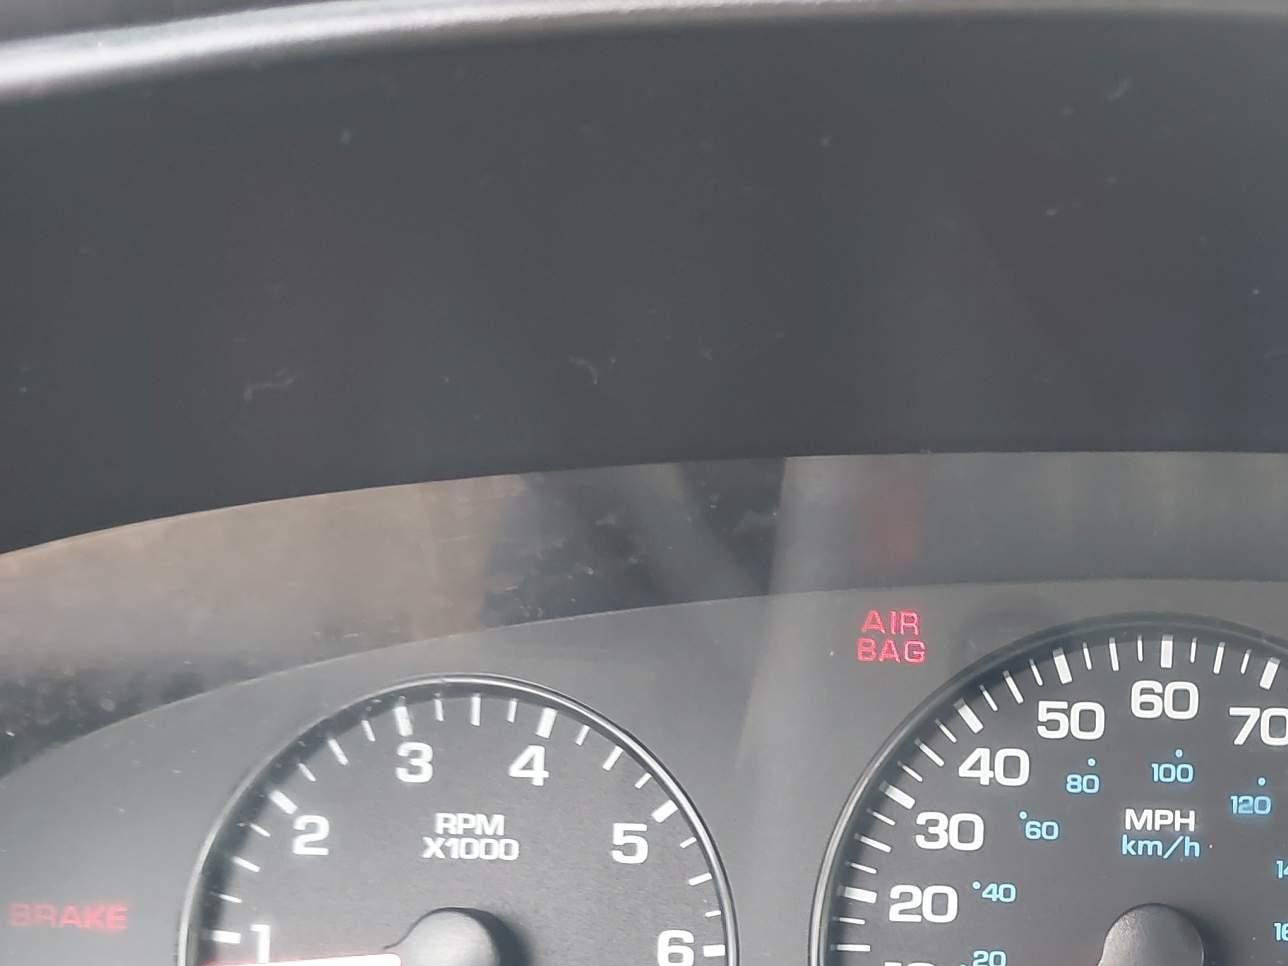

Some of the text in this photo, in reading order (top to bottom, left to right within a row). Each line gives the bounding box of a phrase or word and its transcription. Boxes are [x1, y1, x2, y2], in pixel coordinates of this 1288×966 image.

[862, 610, 920, 635] AIR
[857, 639, 925, 663] BAG
[1131, 680, 1199, 718] 60
[1037, 702, 1105, 739] 50
[396, 744, 433, 782] 3
[510, 746, 549, 786] 4
[958, 748, 1030, 786] 40
[1152, 763, 1194, 783] 100
[1066, 774, 1099, 793] 80
[1231, 795, 1271, 814] 120
[435, 813, 505, 836] RPM
[915, 813, 984, 850] 30
[1025, 821, 1059, 840] 60
[1125, 809, 1196, 831] MPH
[293, 816, 330, 856] 2
[611, 824, 649, 864] 5
[1121, 836, 1200, 858] km/h
[422, 838, 520, 861] X1000
[889, 885, 957, 923] 20
[982, 884, 1016, 902] 40
[9, 905, 128, 931] BRAKE
[251, 924, 271, 964] 1
